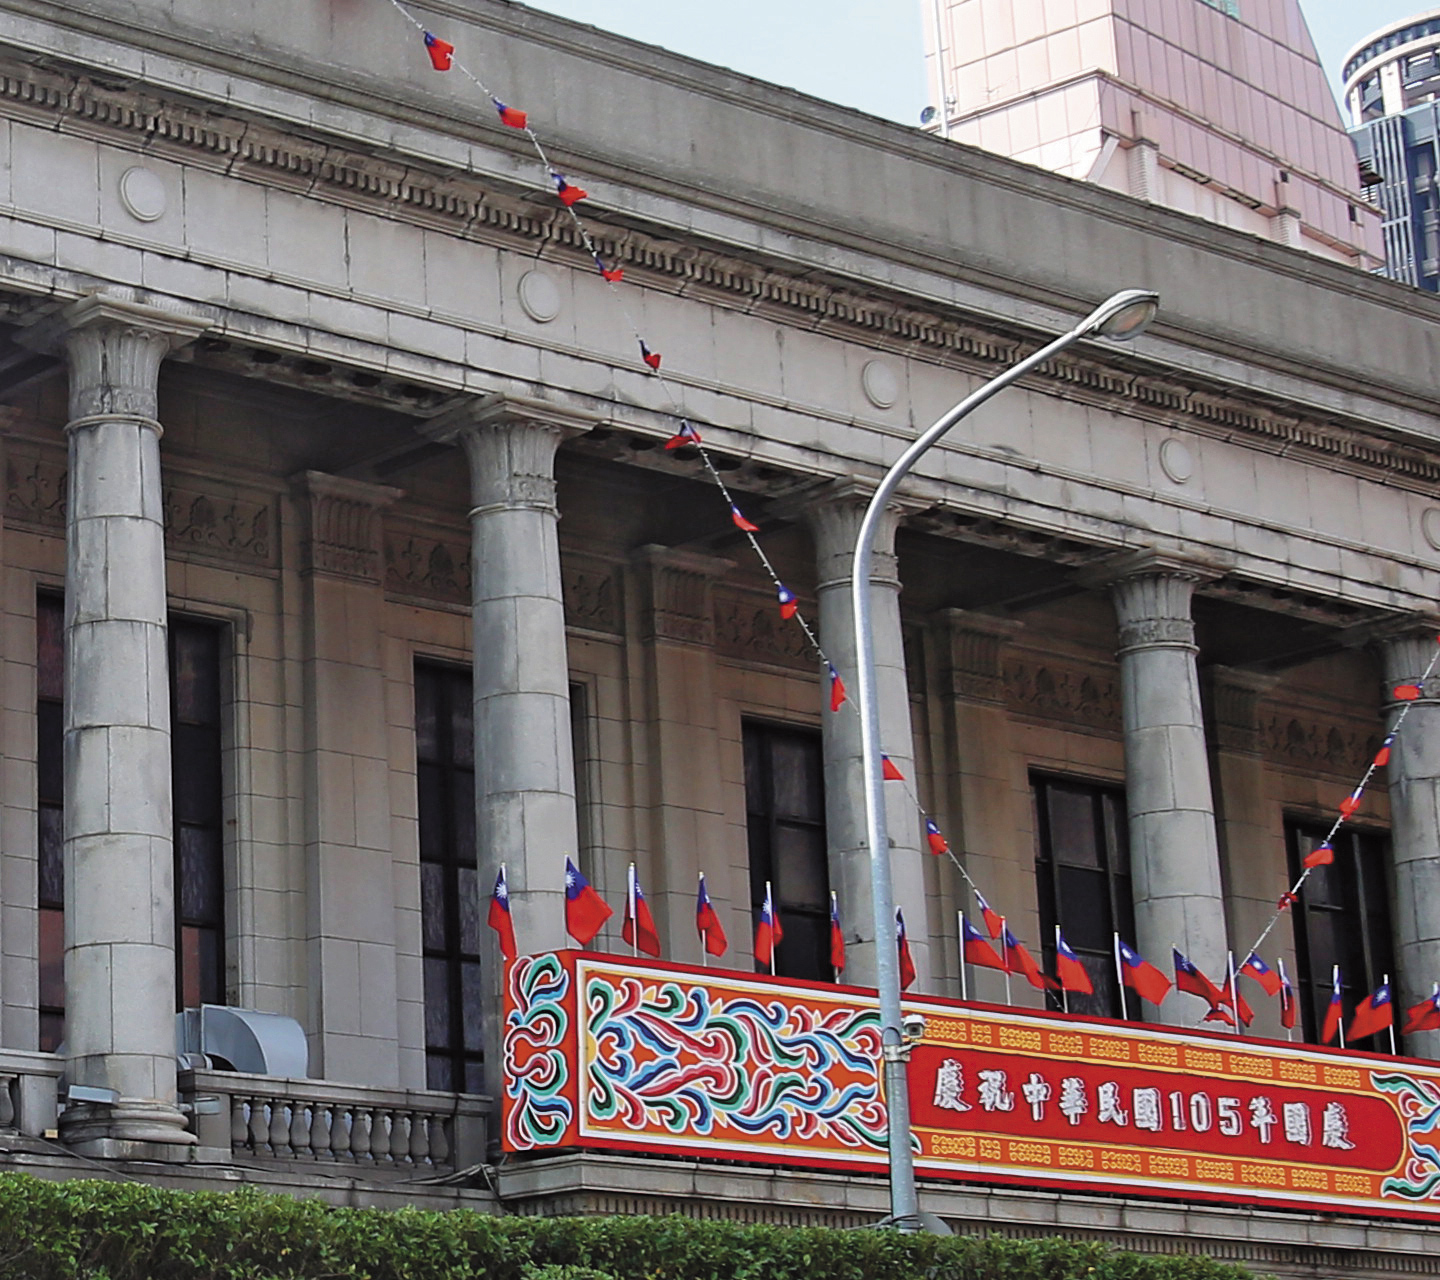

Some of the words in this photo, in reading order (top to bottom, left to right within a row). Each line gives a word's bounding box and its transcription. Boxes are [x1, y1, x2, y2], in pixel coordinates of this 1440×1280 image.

[932, 1057, 1357, 1151] 慶祝中華民國105年國慶
